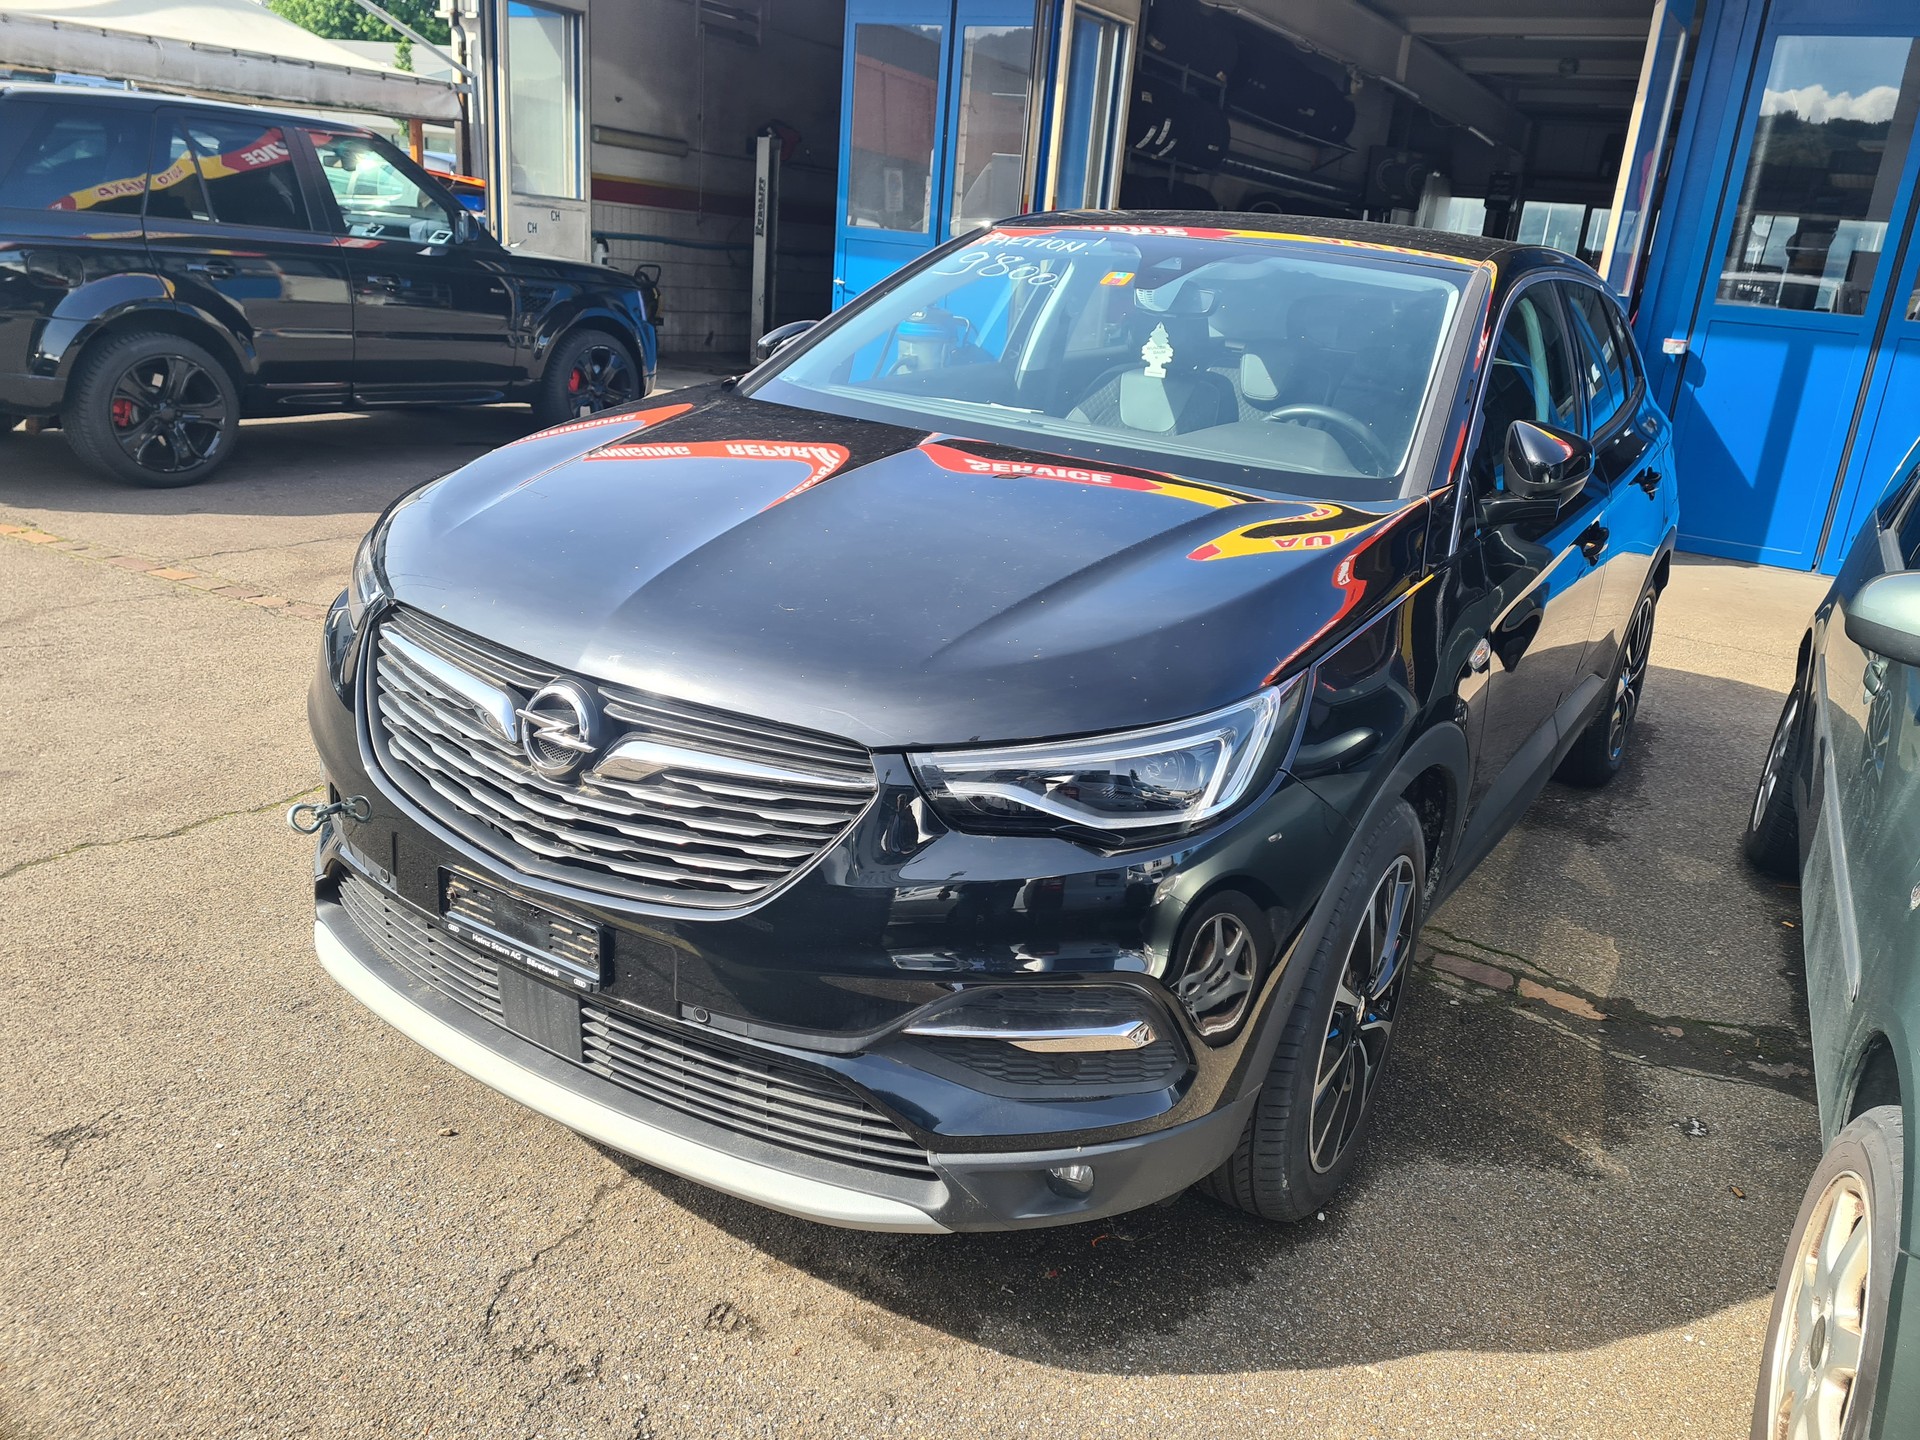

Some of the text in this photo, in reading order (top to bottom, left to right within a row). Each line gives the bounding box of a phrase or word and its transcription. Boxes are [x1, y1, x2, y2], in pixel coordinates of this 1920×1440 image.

[551, 210, 561, 221] CH
[527, 222, 538, 233] CH
[472, 933, 491, 947] Heinz
[491, 942, 510, 956] Stern
[510, 951, 522, 960] AG
